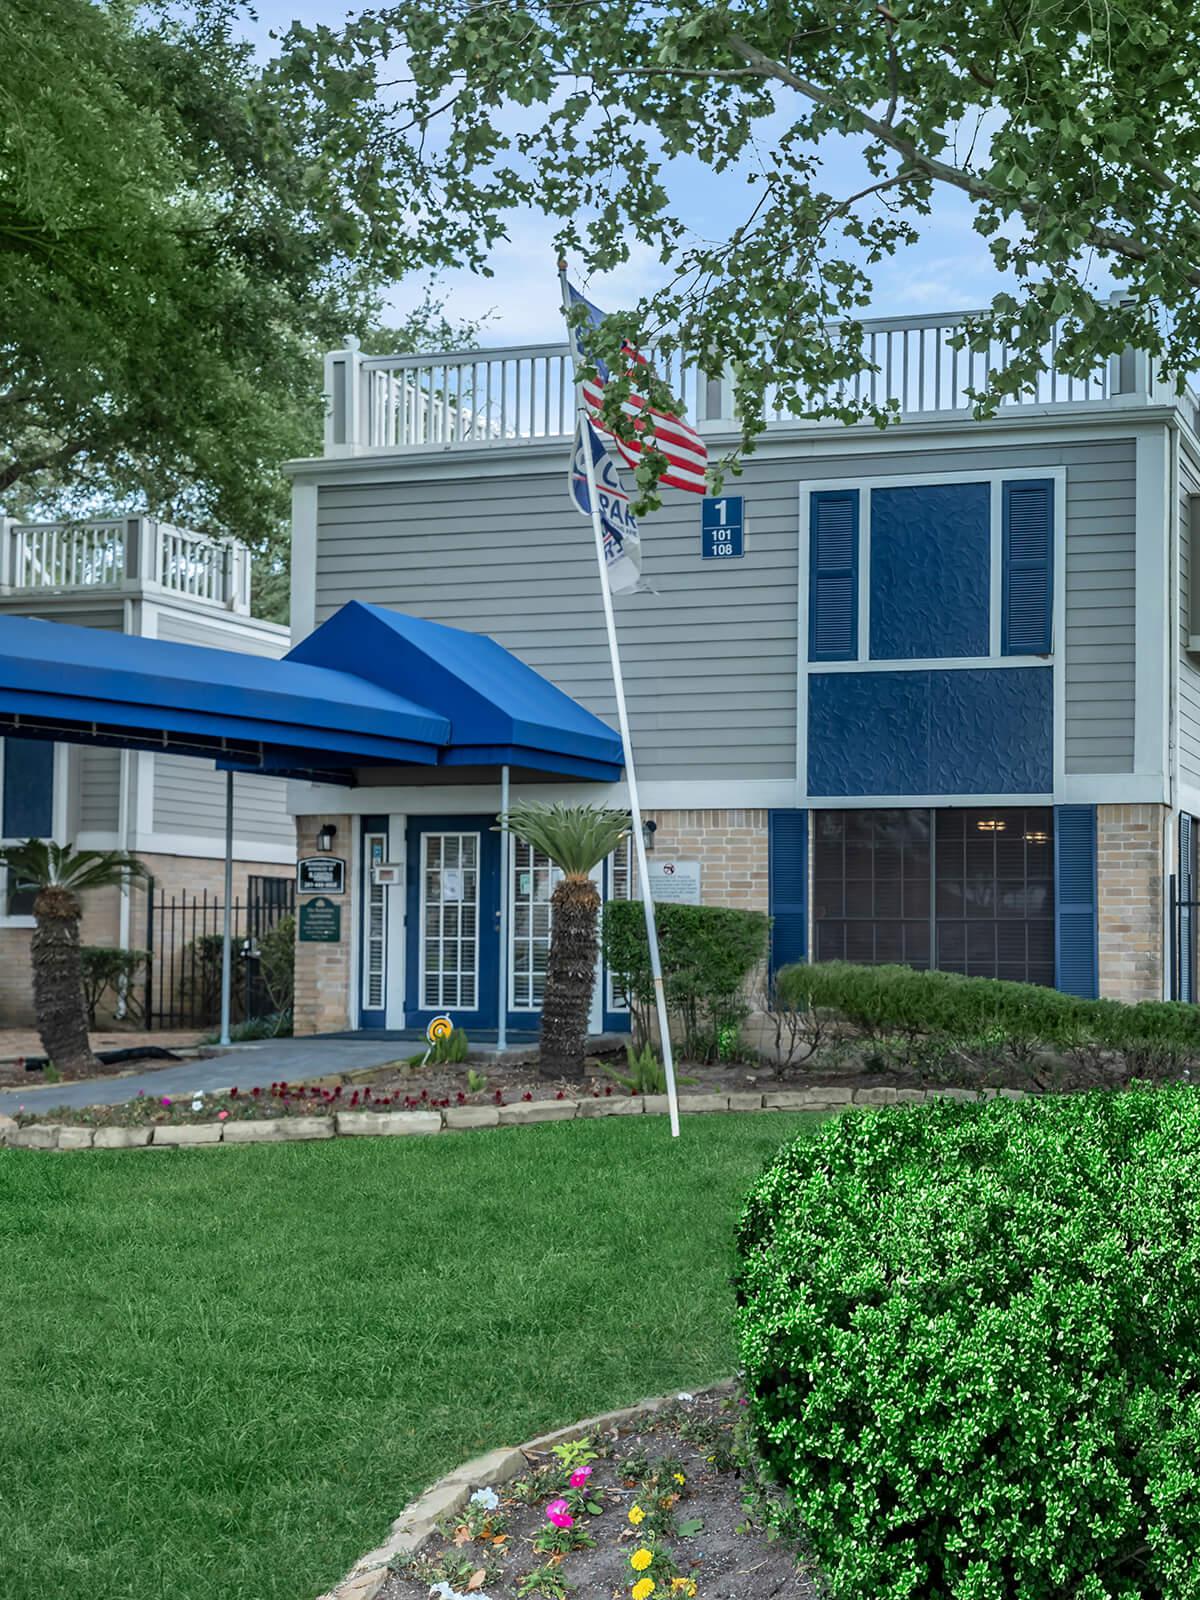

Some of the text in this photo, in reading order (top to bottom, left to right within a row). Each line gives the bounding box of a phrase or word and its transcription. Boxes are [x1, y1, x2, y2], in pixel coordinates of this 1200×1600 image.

[714, 499, 727, 525] 1
[711, 529, 731, 541] 101
[711, 543, 733, 556] 108
